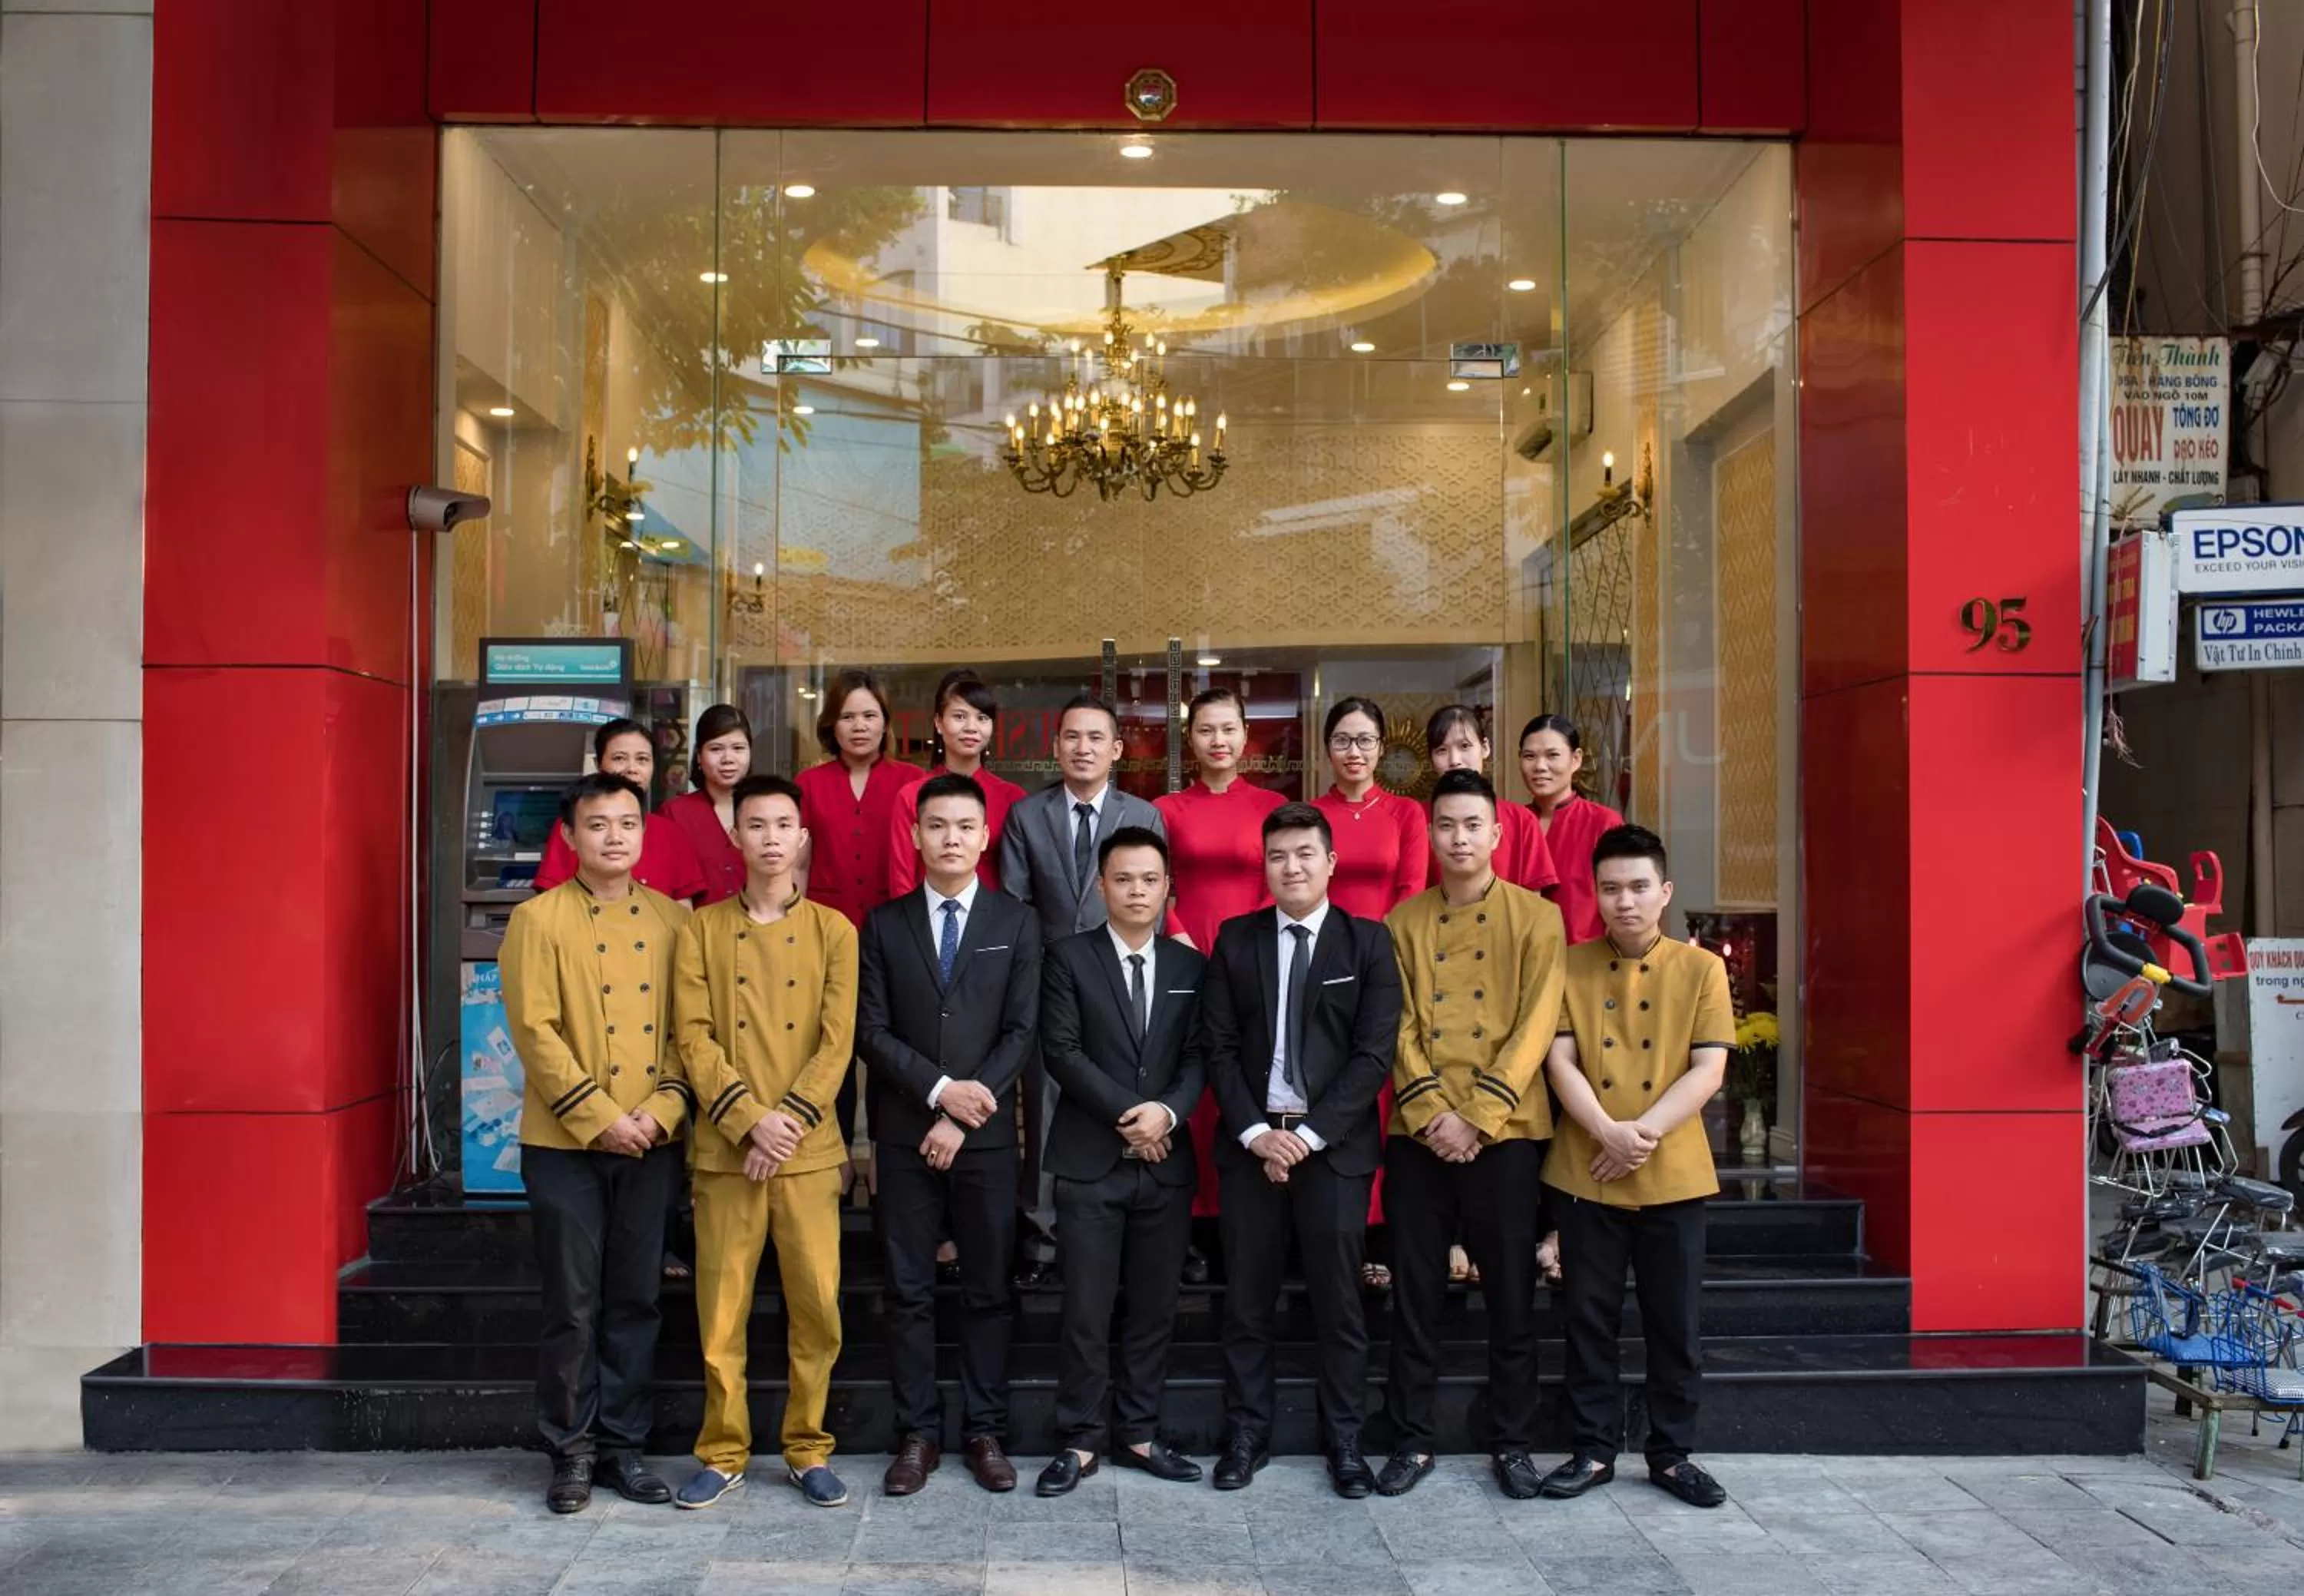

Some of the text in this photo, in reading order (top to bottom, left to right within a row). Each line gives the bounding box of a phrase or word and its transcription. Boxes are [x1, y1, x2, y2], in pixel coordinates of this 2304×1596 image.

[2160, 344, 2220, 366] Thành
[2185, 373, 2218, 388] BÔNG
[2186, 392, 2209, 400] 10M
[2173, 402, 2201, 428] TÔNG
[2113, 406, 2163, 467] QUAY
[2199, 434, 2219, 459] KÉO
[2131, 470, 2160, 485] NHANH
[2194, 558, 2304, 574] EXCEED YOUR VISI
[1960, 595, 2031, 654] 95
[2203, 644, 2226, 665] Vật
[2247, 643, 2262, 661] In
[2256, 974, 2289, 988] trong
